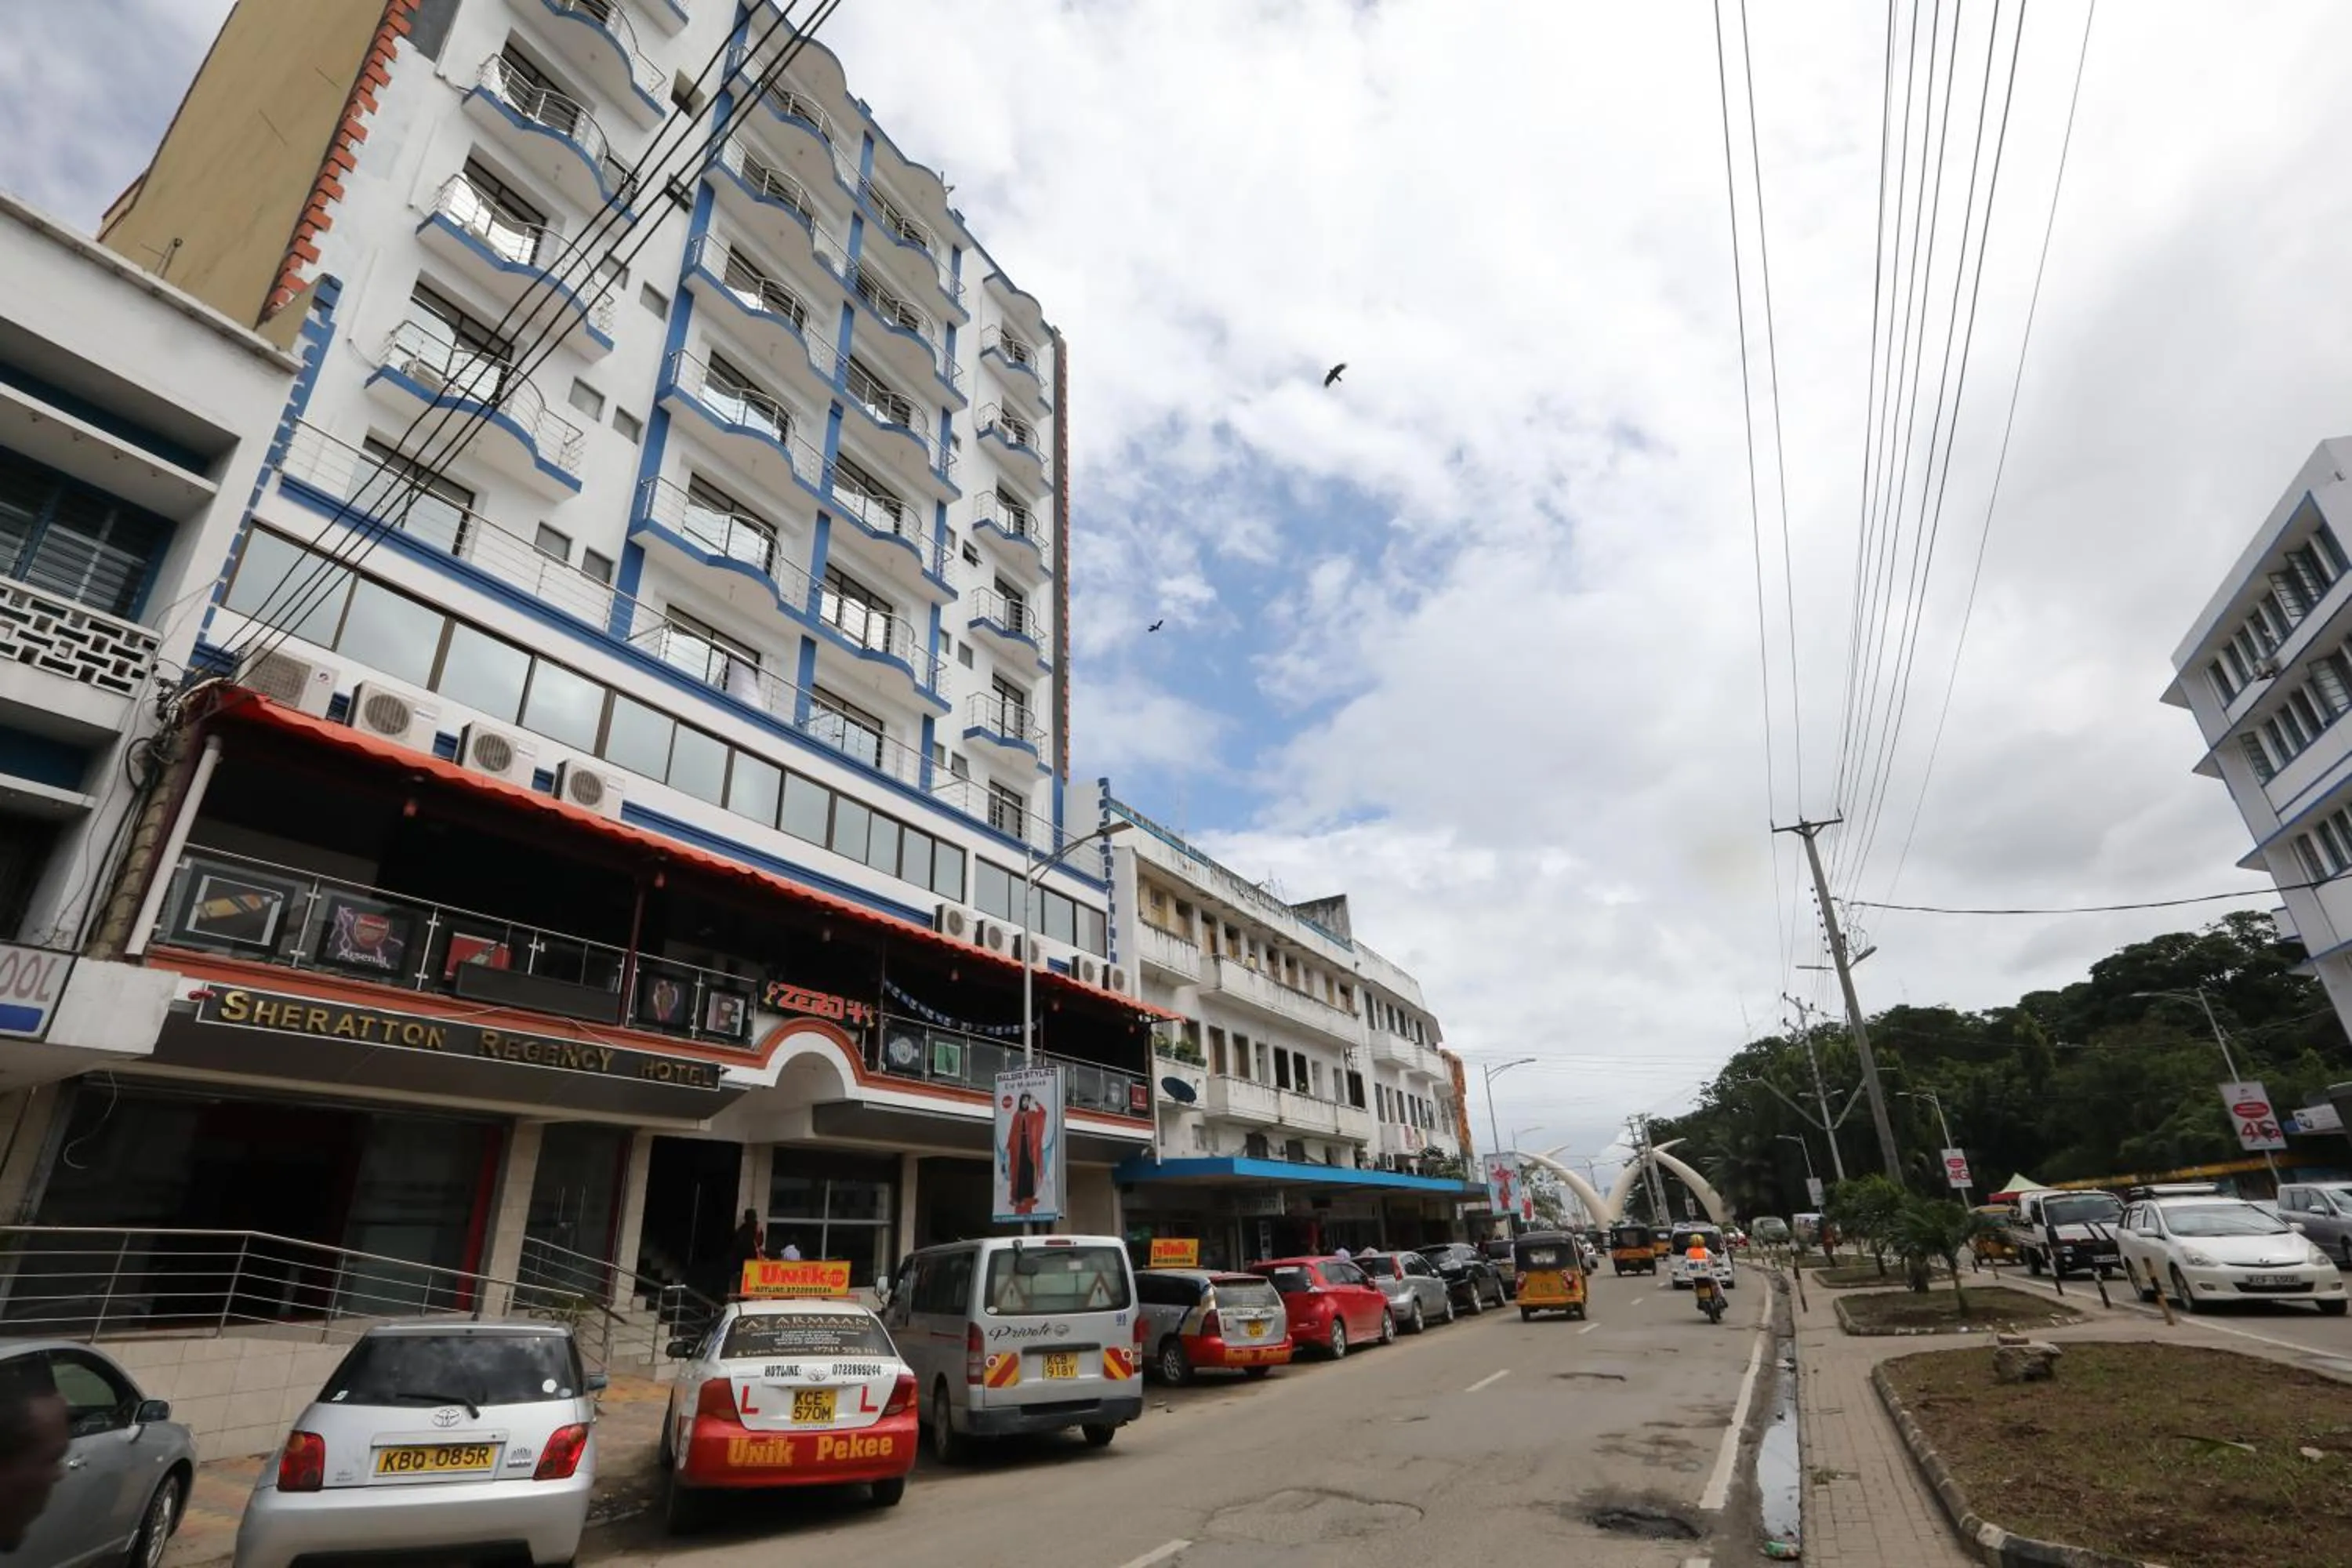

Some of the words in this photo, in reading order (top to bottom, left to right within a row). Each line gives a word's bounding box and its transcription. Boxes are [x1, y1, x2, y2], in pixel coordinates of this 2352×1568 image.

[220, 990, 447, 1048] SHERATTON
[479, 1029, 615, 1072] REGENCY
[641, 1058, 713, 1085] HOTEL
[776, 1316, 869, 1326] ARMAAN
[989, 1323, 1051, 1341] Private
[741, 1385, 759, 1414] L
[860, 1385, 878, 1413] L
[793, 1406, 831, 1420] 570M
[436, 1445, 489, 1467] 085R
[728, 1436, 795, 1467] Unik
[816, 1433, 894, 1461] Pekee
